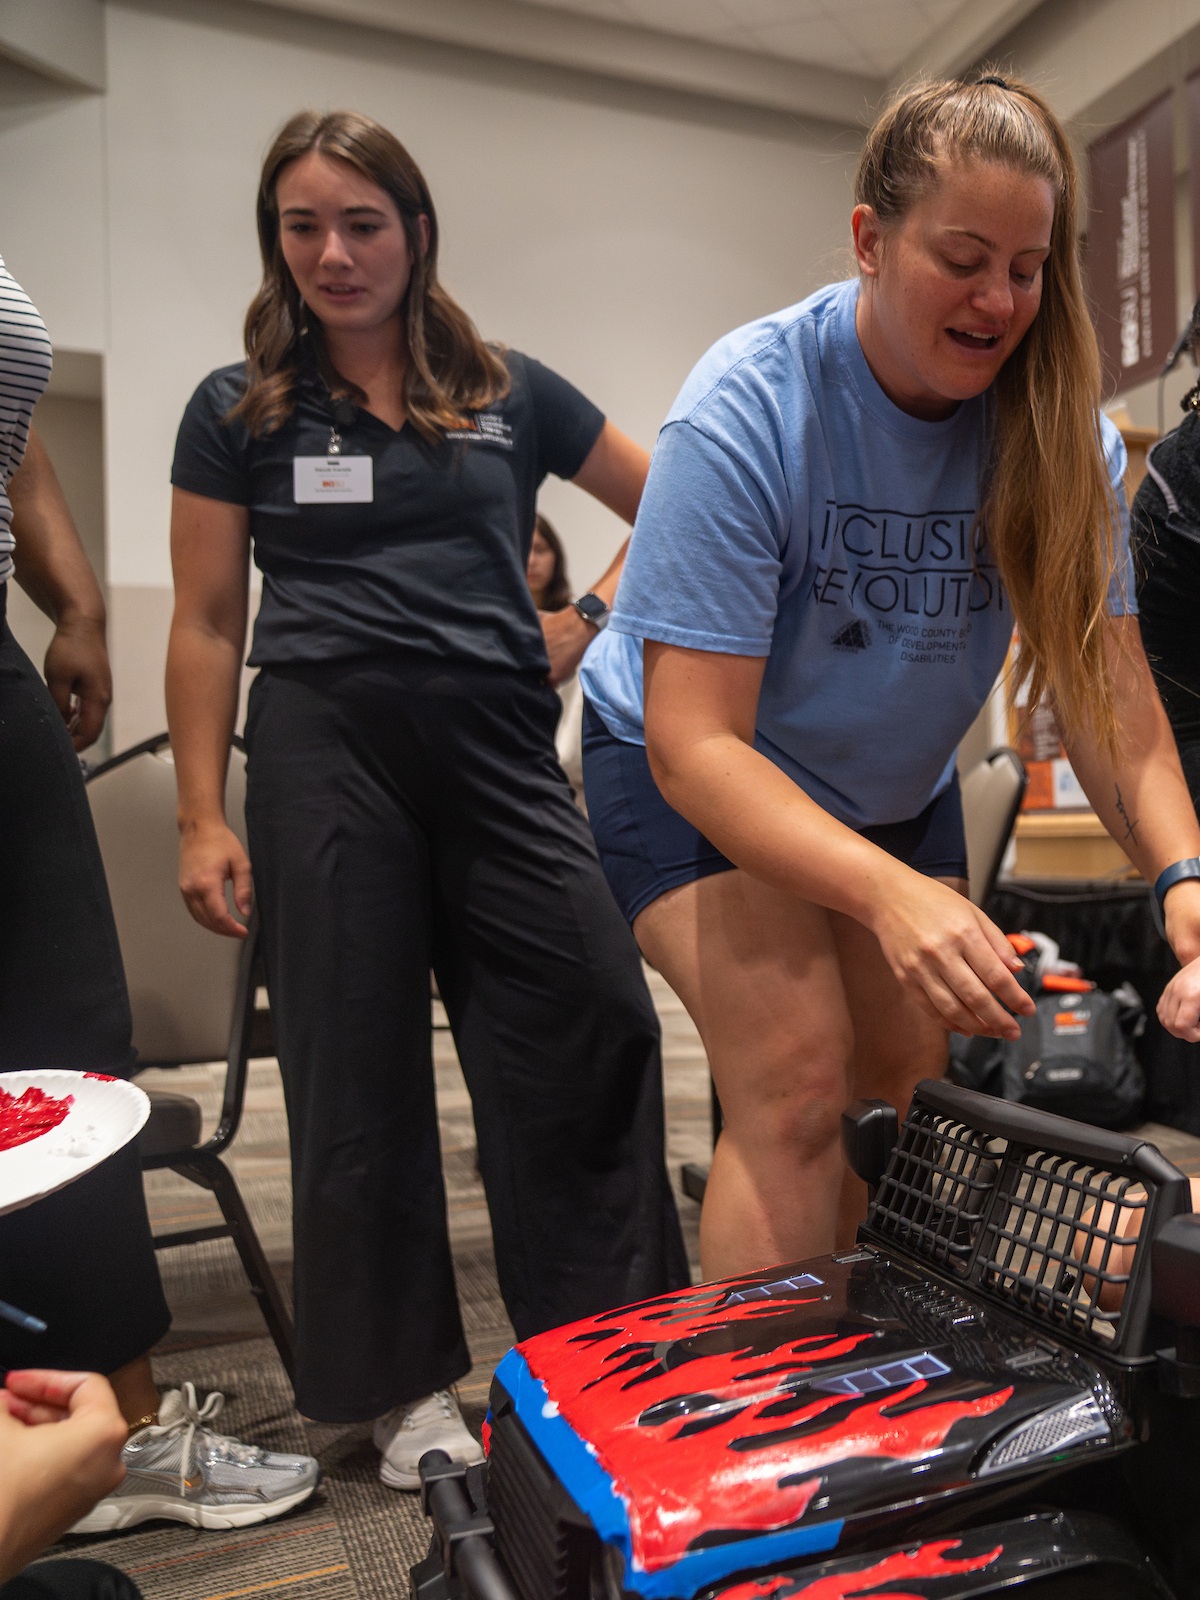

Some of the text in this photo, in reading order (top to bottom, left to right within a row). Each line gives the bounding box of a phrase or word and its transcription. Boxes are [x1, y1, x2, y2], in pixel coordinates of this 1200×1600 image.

[877, 620, 895, 634] THE
[921, 628, 956, 640] COUNTY
[888, 634, 900, 646] OF
